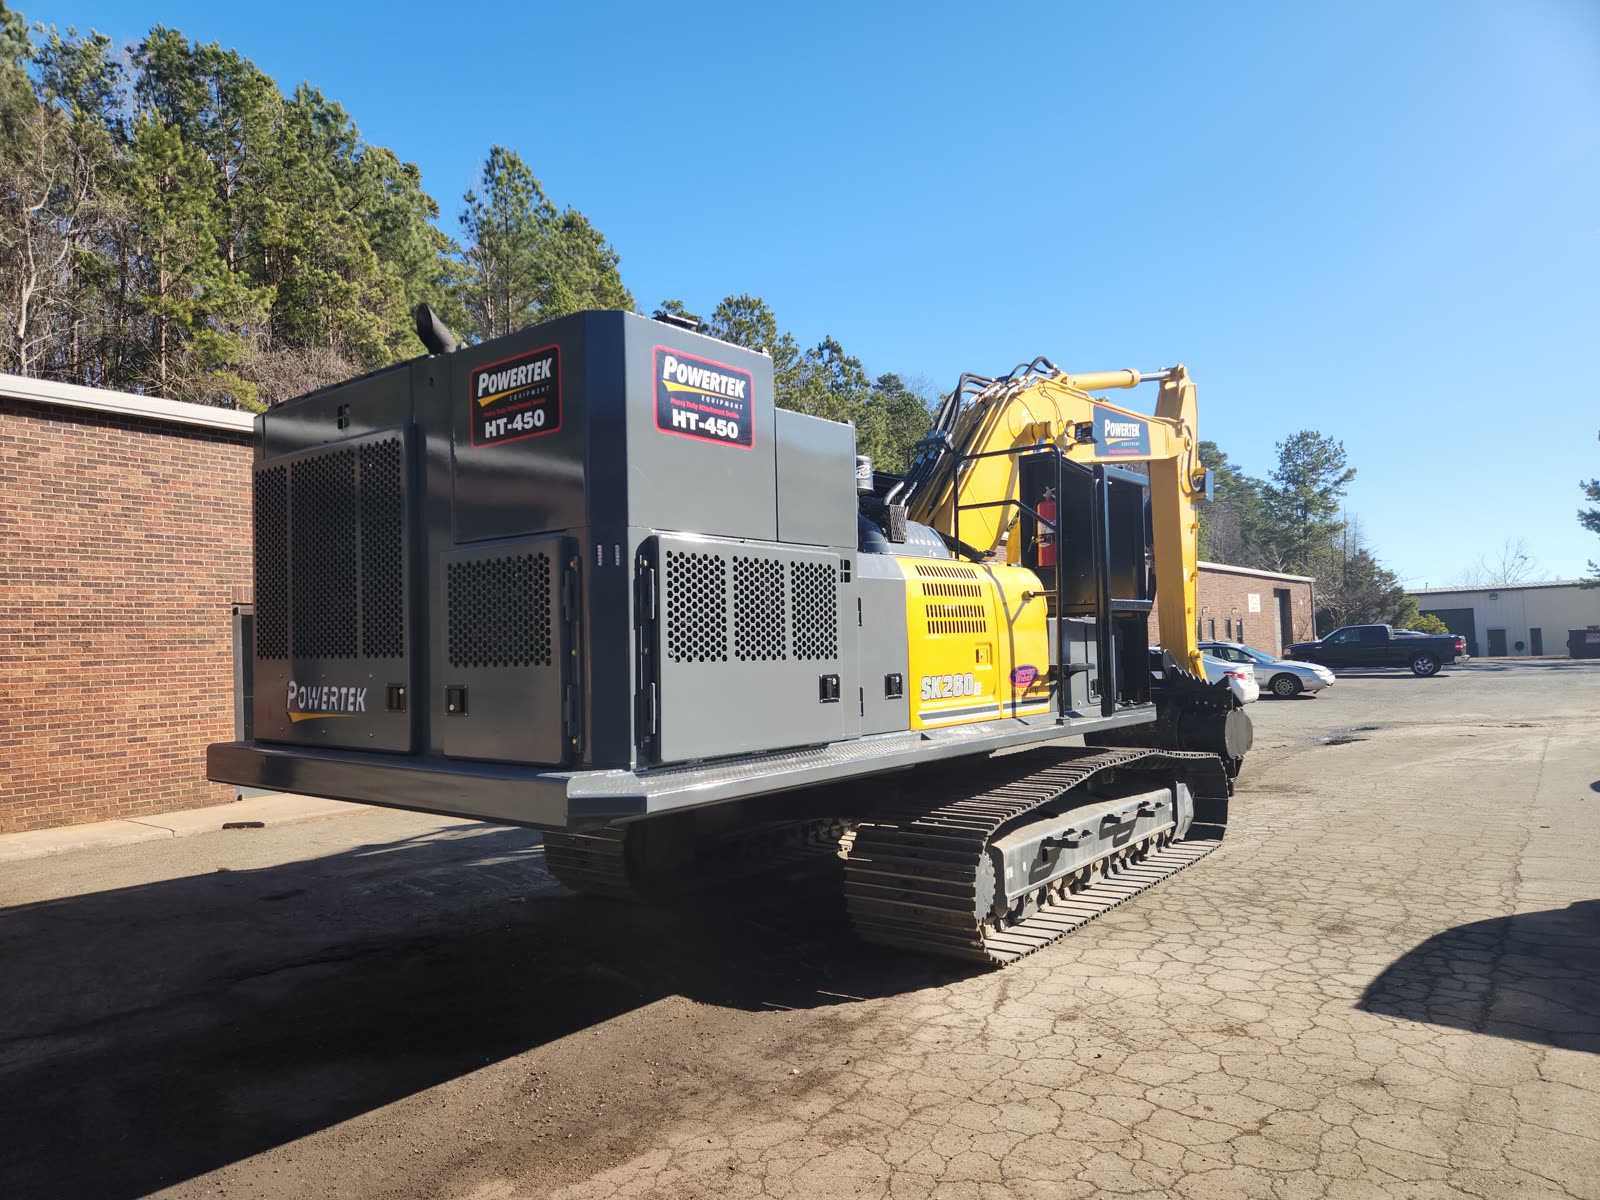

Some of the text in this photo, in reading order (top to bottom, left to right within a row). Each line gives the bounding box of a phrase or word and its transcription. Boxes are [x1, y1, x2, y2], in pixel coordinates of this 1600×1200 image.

[477, 357, 552, 397] POWERTEK
[663, 355, 746, 398] POWERTEK
[509, 385, 550, 401] EQUIPMENT
[701, 395, 743, 410] EQUIPMENT
[484, 409, 545, 439] HT-450
[672, 408, 739, 439] HT-450
[1104, 419, 1140, 437] POWERTEK
[286, 680, 367, 712] POWERTEK
[921, 672, 975, 701] SK260
